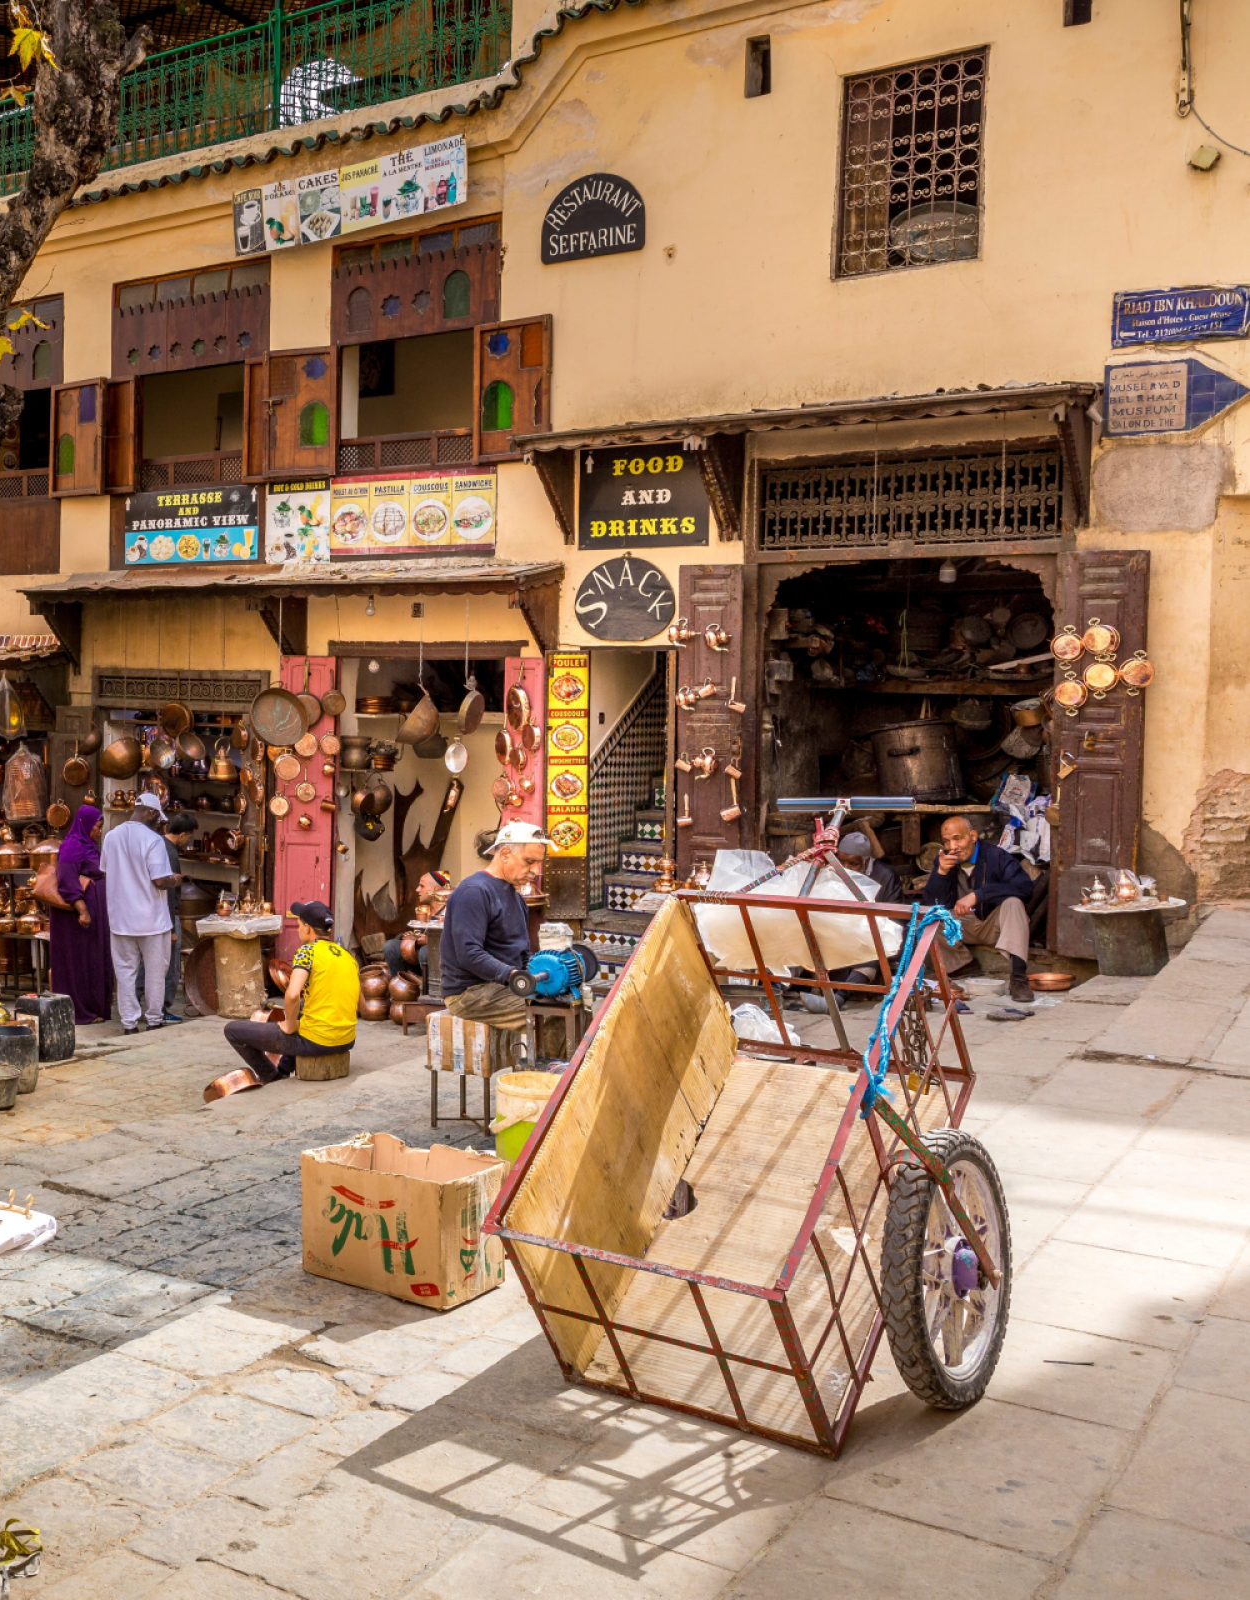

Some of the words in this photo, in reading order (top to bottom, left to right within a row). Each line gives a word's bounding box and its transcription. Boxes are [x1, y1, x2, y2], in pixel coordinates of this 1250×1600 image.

[424, 138, 466, 157] LIMONADE
[389, 150, 415, 167] THÉ
[398, 161, 424, 174] MENTHE
[298, 173, 339, 190] CAKES
[341, 171, 352, 182] JUS
[545, 180, 643, 232] RESTAURANT
[549, 223, 637, 256] SEFFARINE
[1124, 301, 1152, 315] RIAD
[1154, 299, 1175, 313] IBN
[1176, 292, 1245, 311] KHALDOUN
[1110, 395, 1133, 405] BEL
[1111, 404, 1177, 417] MUSEUM
[1143, 419, 1157, 428] DE
[612, 454, 685, 476] FOOD
[374, 485, 405, 494] PASTILLA
[413, 482, 449, 492] COUSCOUS
[156, 491, 224, 507] TERRASSE
[621, 488, 672, 506] AND
[178, 507, 200, 516] AND
[132, 516, 209, 531] PANORAMIC
[212, 514, 250, 526] VIEW
[590, 516, 696, 538] DRINKS
[575, 558, 673, 629] SNACK
[553, 659, 585, 668] POULET
